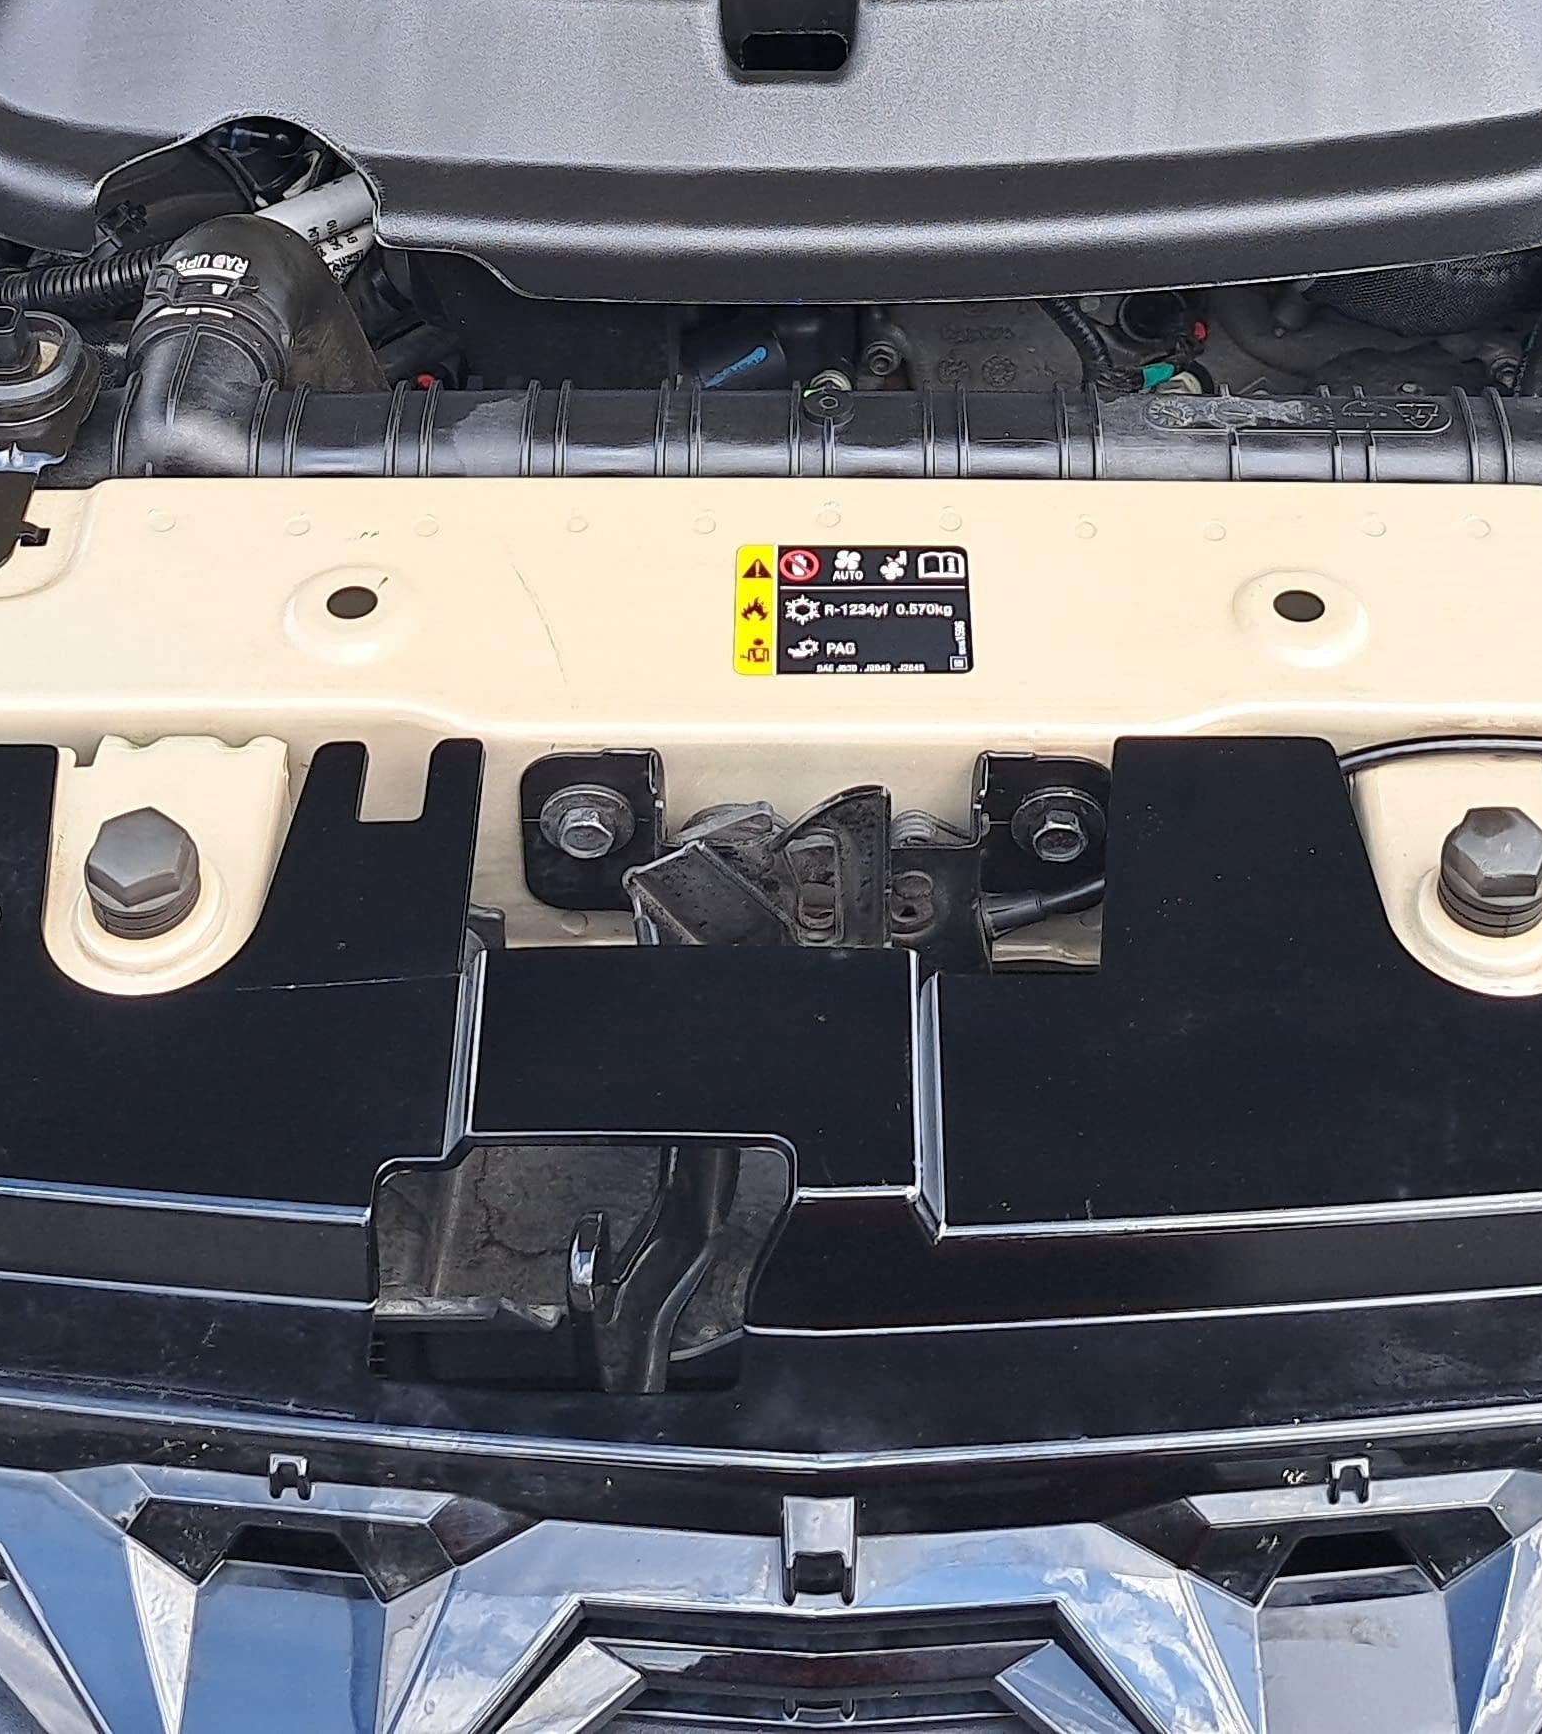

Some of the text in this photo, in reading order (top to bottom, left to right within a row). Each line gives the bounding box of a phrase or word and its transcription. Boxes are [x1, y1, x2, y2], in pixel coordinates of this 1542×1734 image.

[212, 254, 249, 273] RAD
[832, 570, 864, 582] AUTO
[824, 602, 954, 618] R-1234yf 0.570kg
[825, 641, 857, 656] PAG
